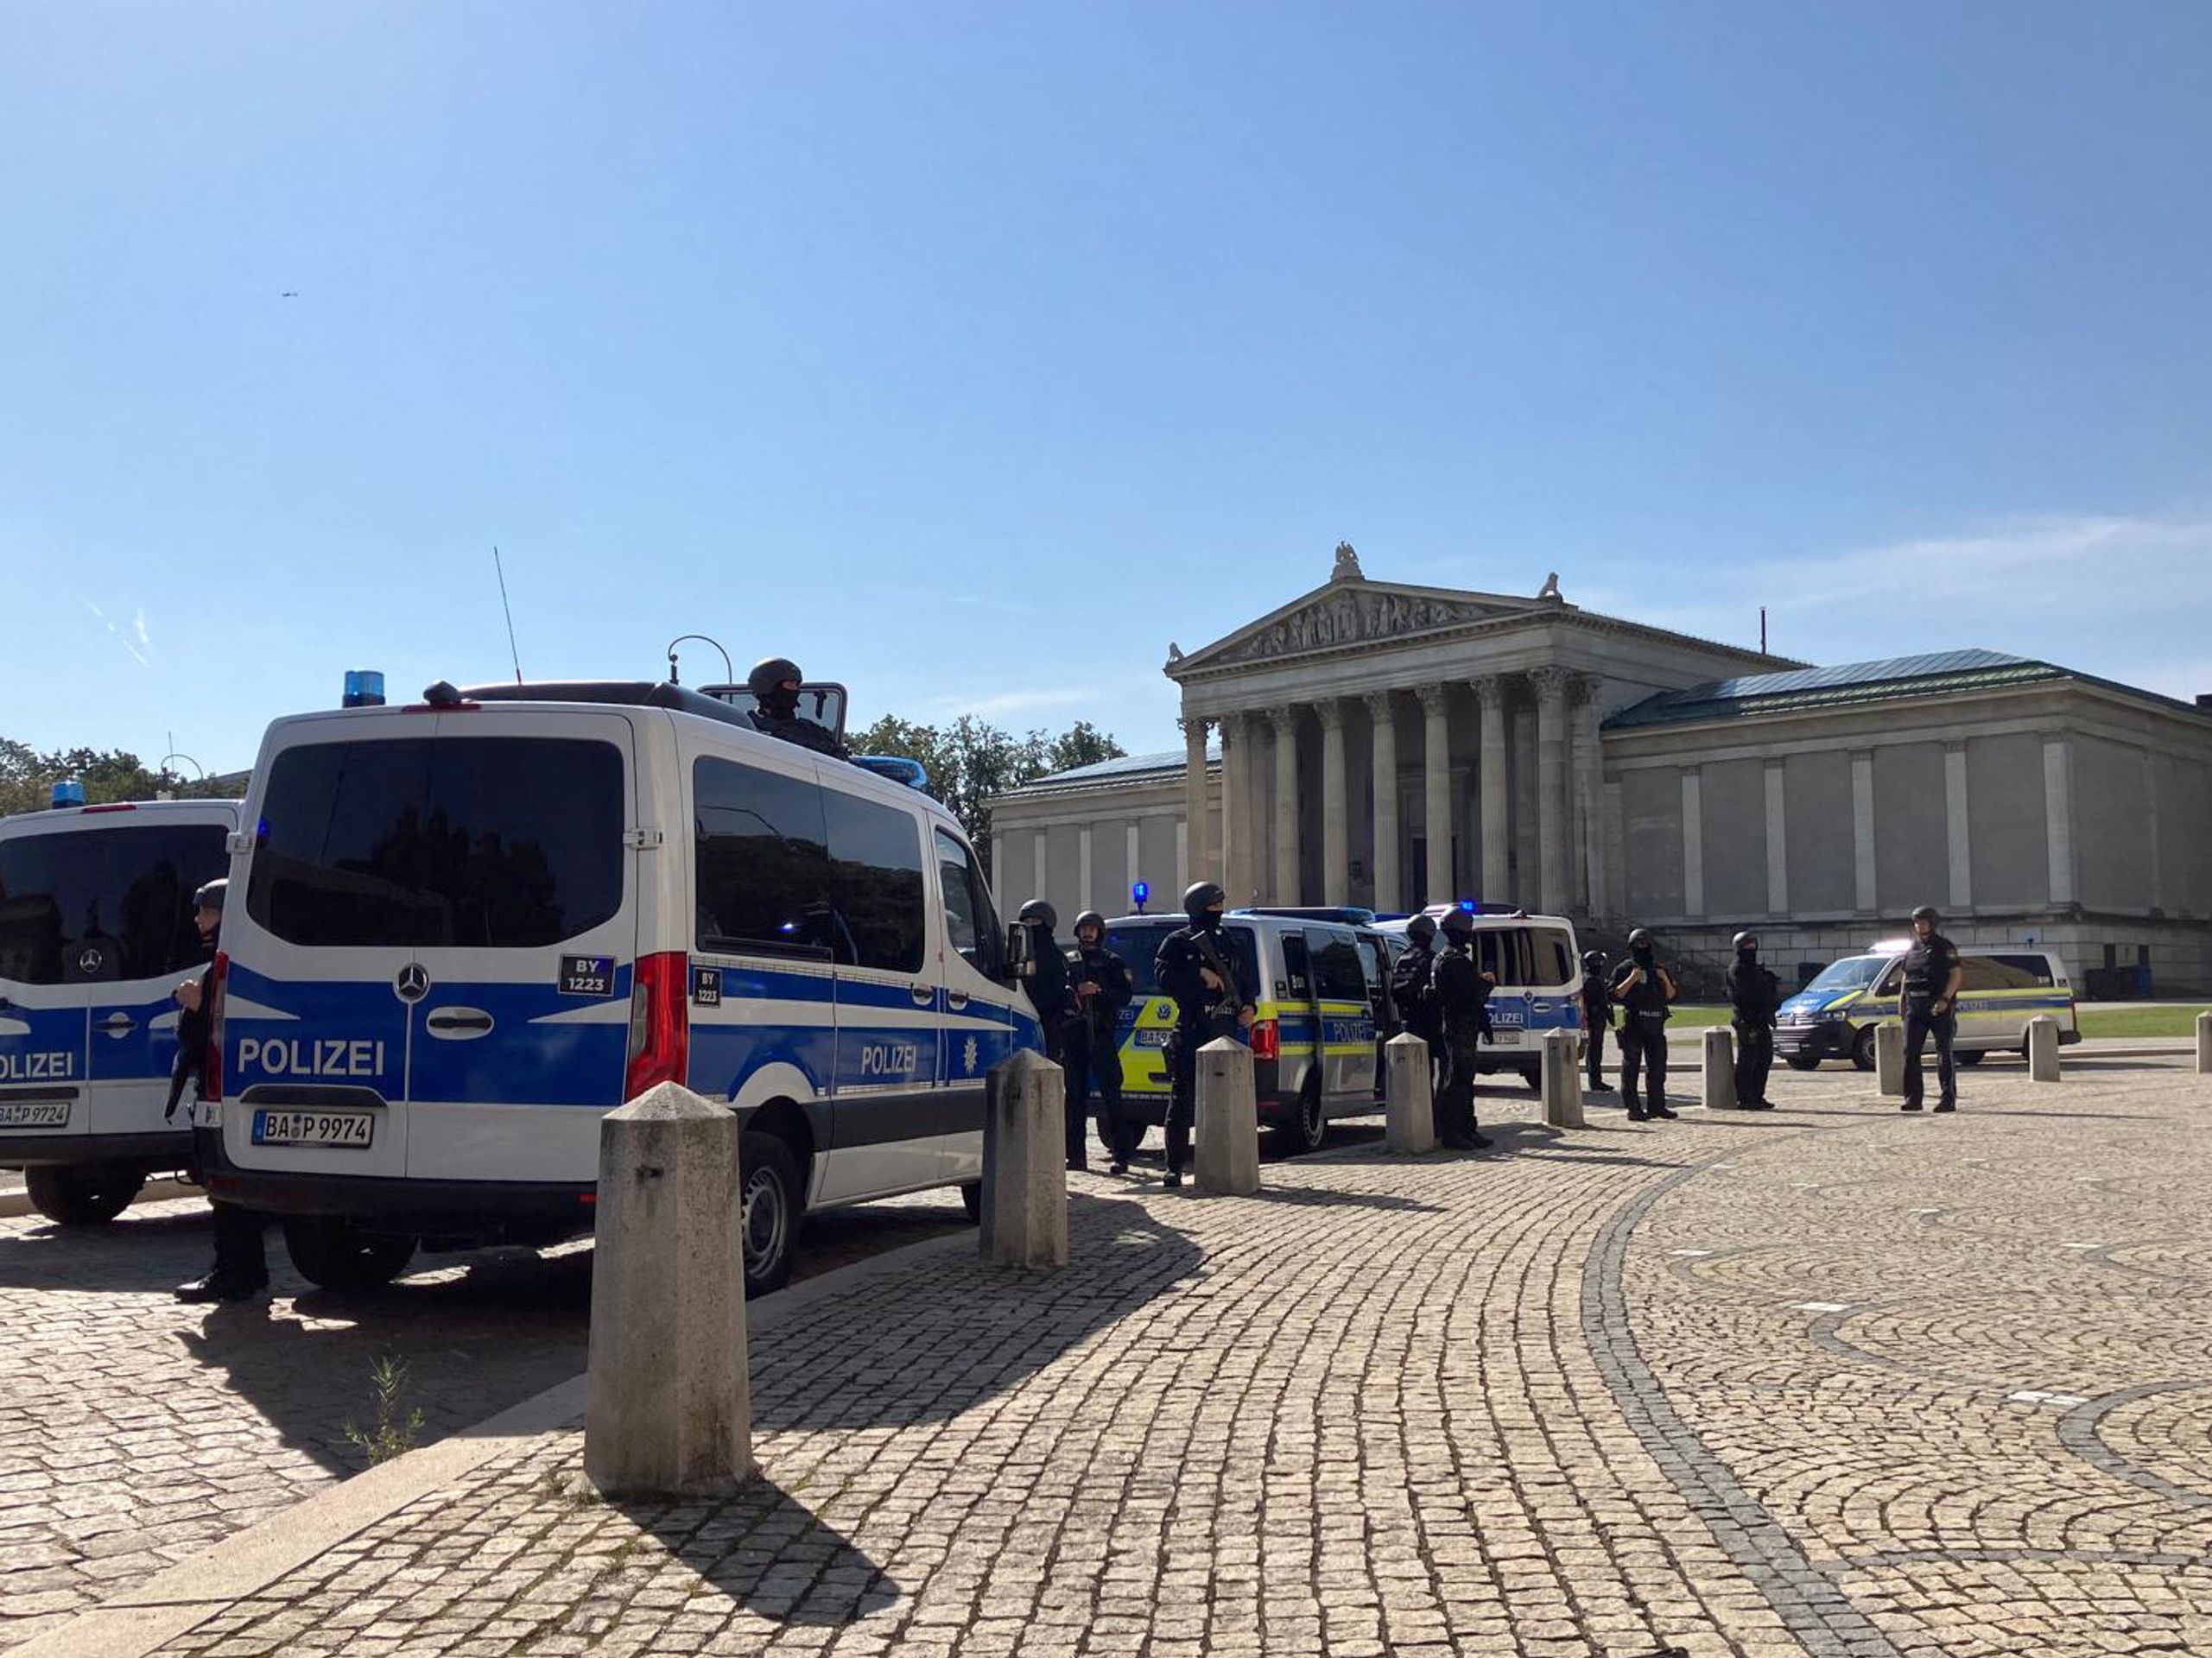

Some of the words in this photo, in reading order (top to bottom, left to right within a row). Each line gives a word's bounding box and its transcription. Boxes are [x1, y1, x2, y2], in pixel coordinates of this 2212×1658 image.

[576, 959, 599, 973] BY
[568, 977, 605, 991] 1223
[701, 972, 714, 984] BY
[699, 990, 718, 1003] 1223
[1488, 1013, 1524, 1024] OLIZEI
[238, 1038, 384, 1076] POLIZEI
[860, 1045, 917, 1075] POLIZEI
[0, 1052, 73, 1079] OLIZEI
[265, 1115, 288, 1138] BA
[303, 1116, 315, 1138] P
[319, 1117, 366, 1141] 9974
